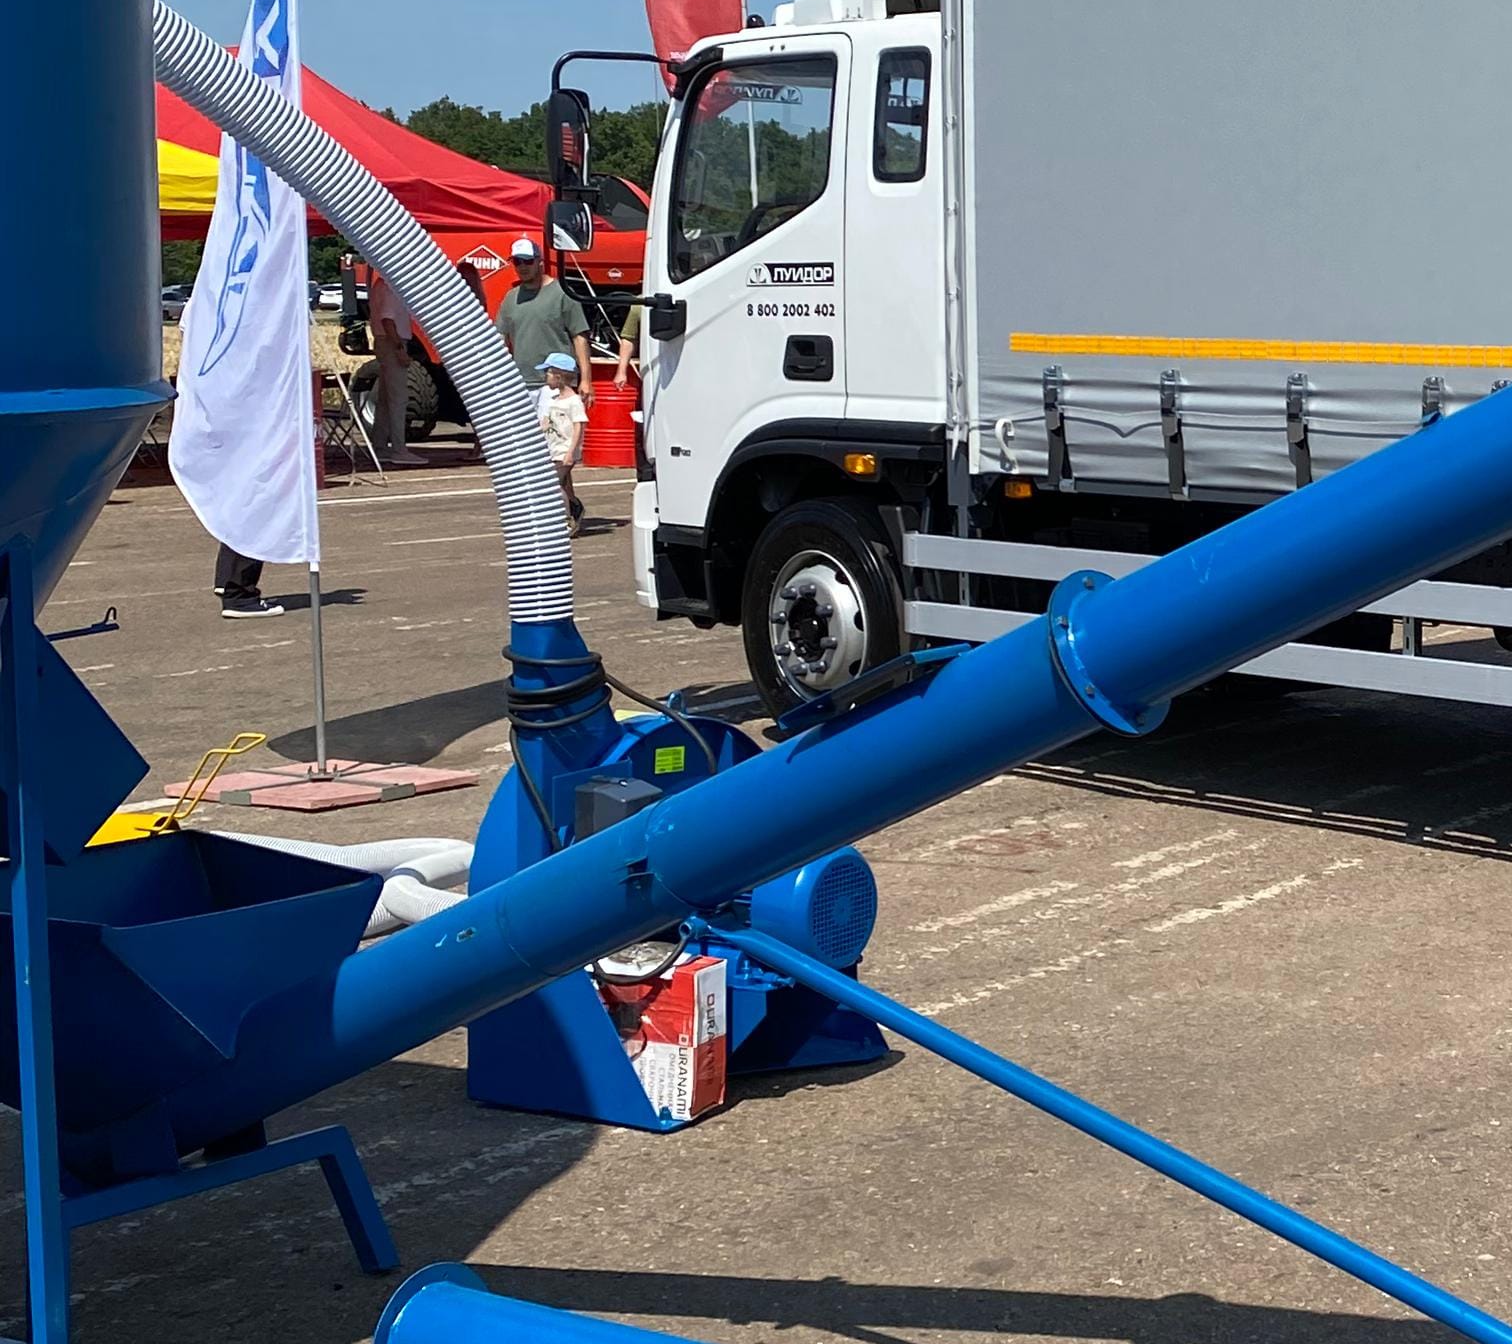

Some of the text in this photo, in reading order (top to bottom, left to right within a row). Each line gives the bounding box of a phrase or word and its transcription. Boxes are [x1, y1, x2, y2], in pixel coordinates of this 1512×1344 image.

[773, 267, 833, 283] ЛУИДОР
[747, 303, 835, 317] 8 800 2002 402
